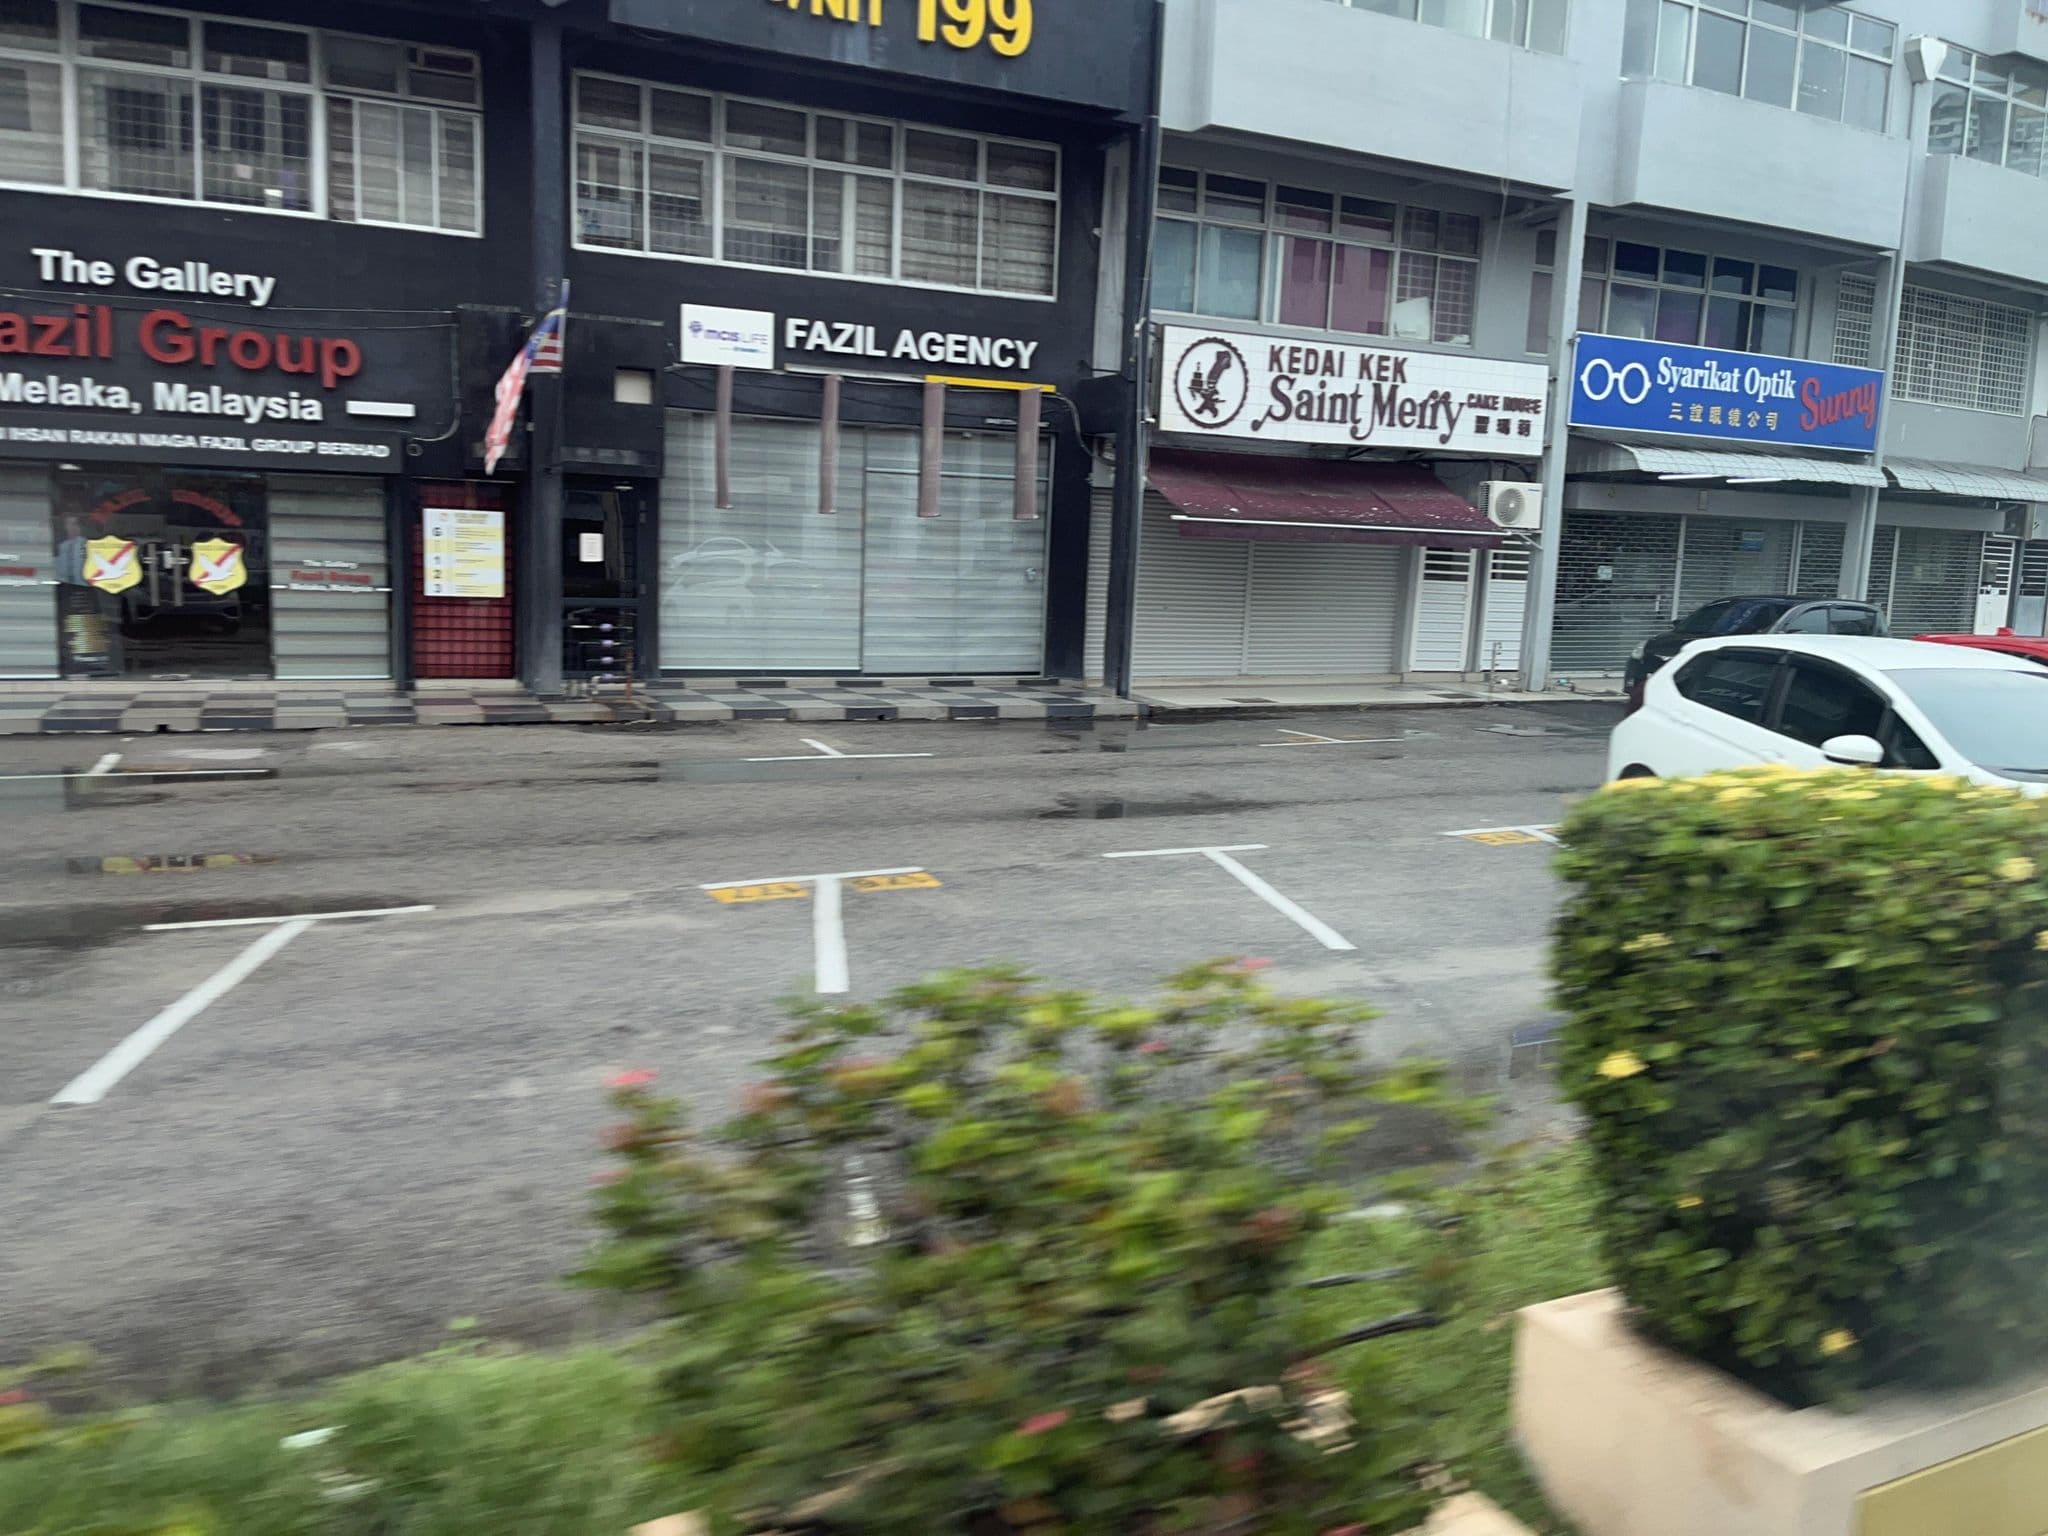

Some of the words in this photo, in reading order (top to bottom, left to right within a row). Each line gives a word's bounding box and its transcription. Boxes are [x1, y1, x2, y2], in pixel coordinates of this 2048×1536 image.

[917, 0, 1033, 57] 199
[30, 247, 116, 286] The
[125, 256, 276, 307] Gallery
[138, 308, 363, 388] Group
[785, 317, 888, 358] FAZIL
[891, 328, 1039, 370] AGENCY
[1268, 344, 1345, 378] KEDAI
[1358, 352, 1409, 384] KEK
[0, 371, 143, 415] Melaka,
[152, 381, 324, 424] Malaysia
[1251, 374, 1363, 432] Saint
[1350, 382, 1464, 445] Merry
[1466, 393, 1499, 411] CAKE
[1502, 396, 1542, 415] HOUSE
[1656, 356, 1741, 394] Syarikat
[1744, 367, 1797, 404] Optik
[1800, 376, 1877, 433] Sunny
[199, 434, 251, 451] FAZIL
[251, 438, 316, 454] GROUP
[317, 441, 391, 458] BERHAD
